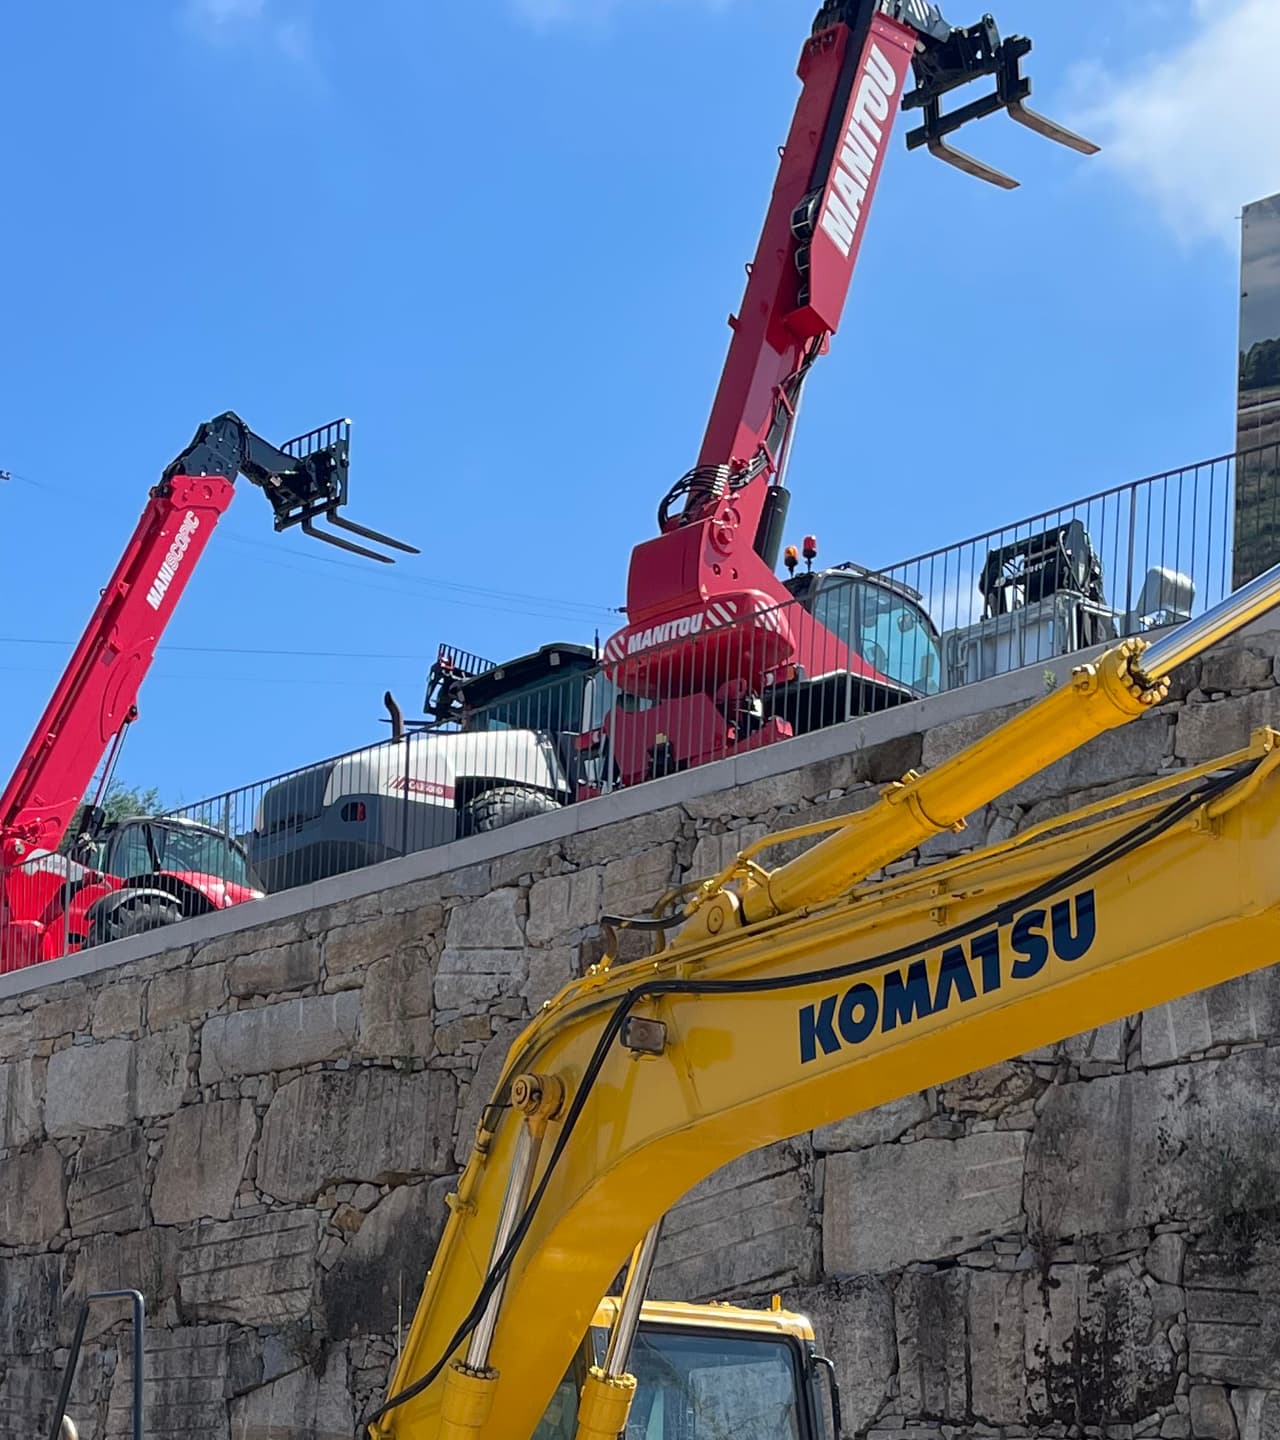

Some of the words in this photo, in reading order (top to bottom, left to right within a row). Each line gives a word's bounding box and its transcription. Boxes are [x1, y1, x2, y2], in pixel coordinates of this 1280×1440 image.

[821, 43, 896, 257] MANITOU
[146, 510, 200, 611] MANISCOPIC
[627, 612, 704, 655] MANITOU
[799, 889, 1096, 1064] KOMATSU
